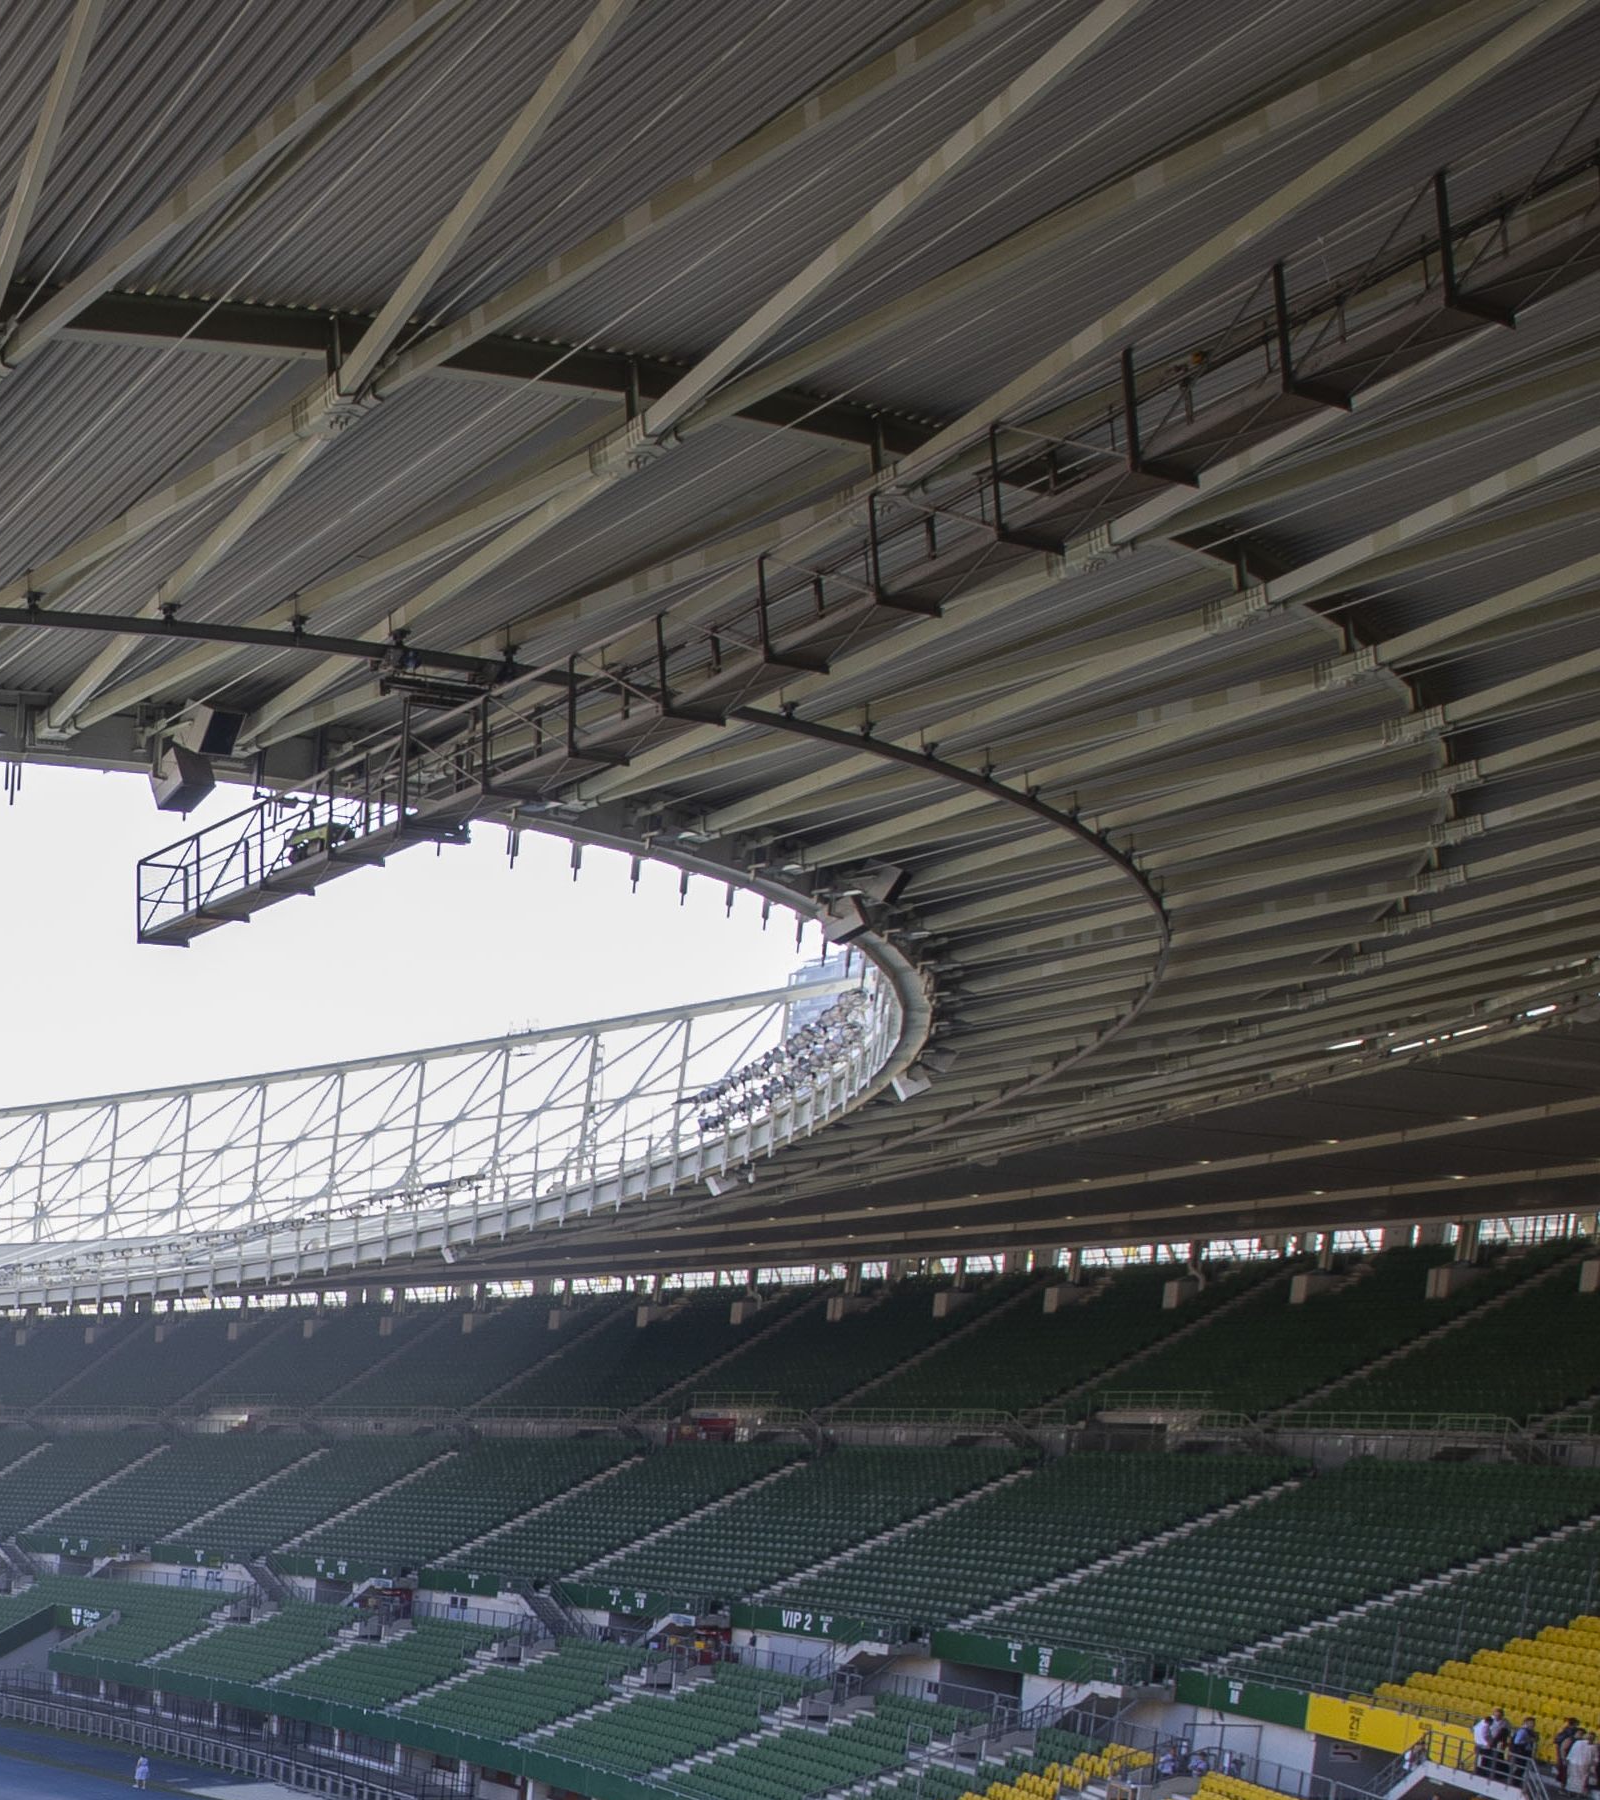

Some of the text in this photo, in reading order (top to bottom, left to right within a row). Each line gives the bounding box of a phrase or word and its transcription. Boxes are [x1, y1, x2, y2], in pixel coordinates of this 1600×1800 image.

[782, 1609, 813, 1632] VIP 2
[822, 1621, 830, 1634] K
[1010, 1650, 1017, 1663] L
[1349, 1715, 1361, 1732] 21
